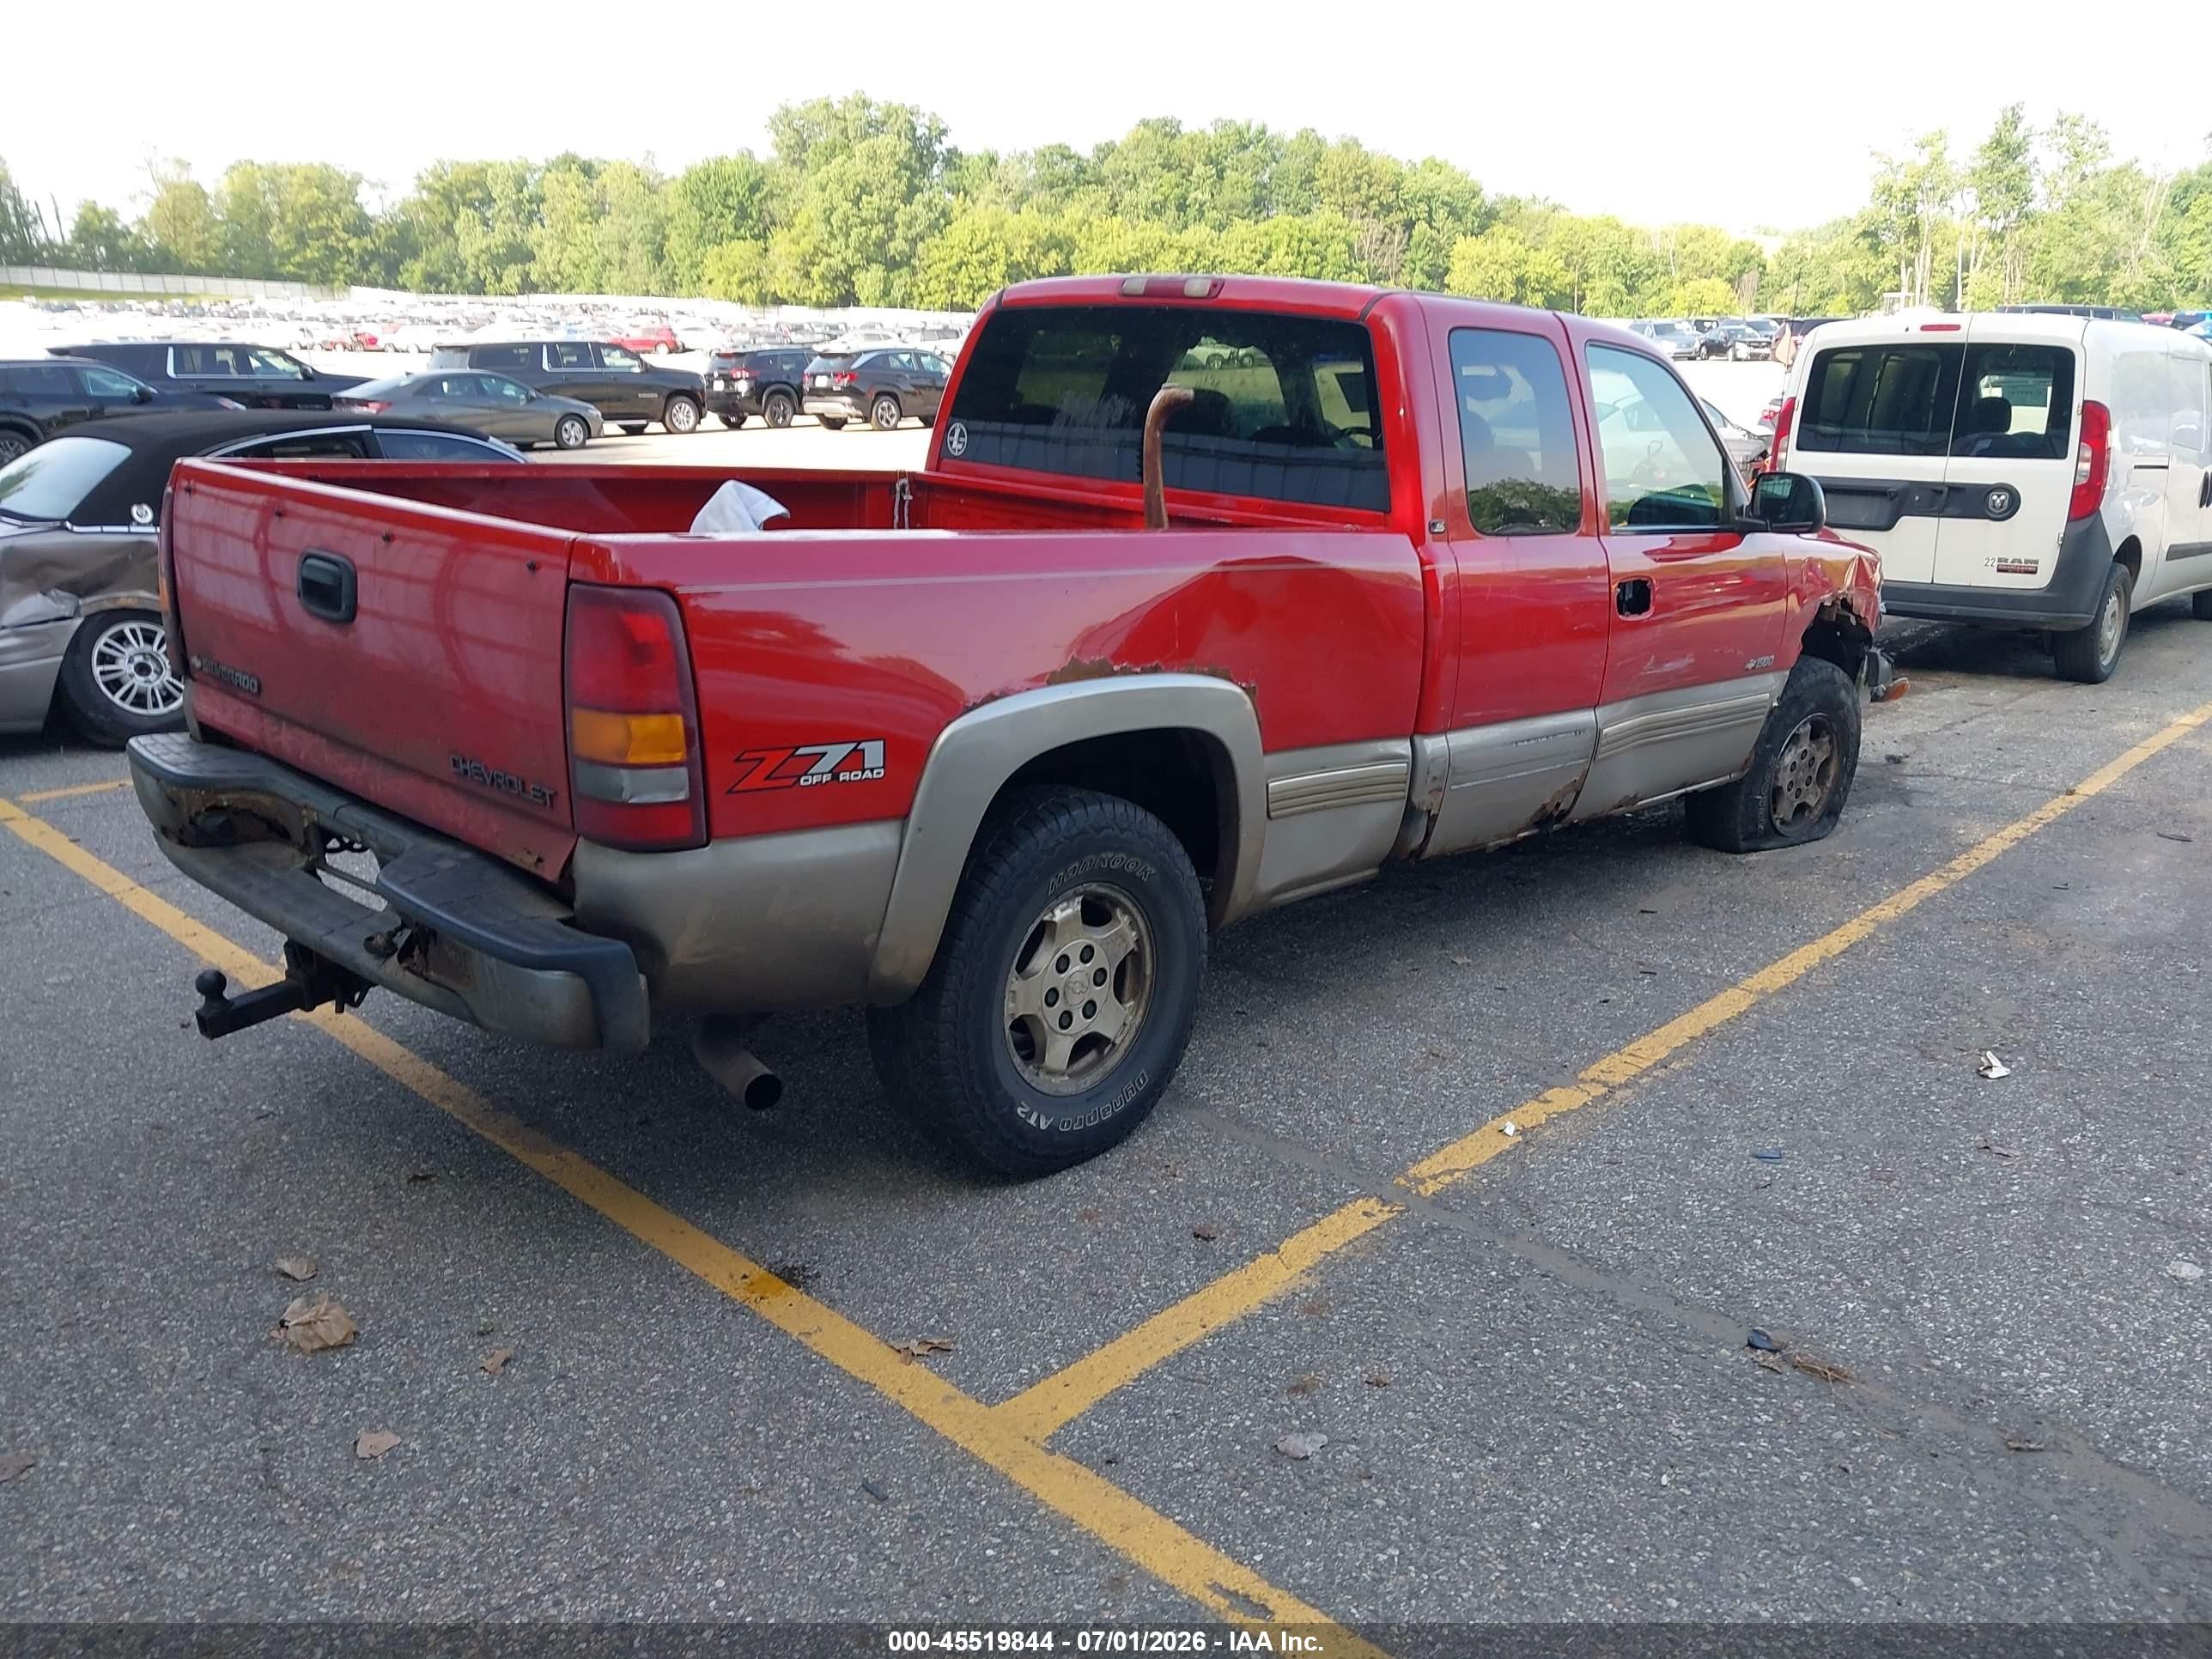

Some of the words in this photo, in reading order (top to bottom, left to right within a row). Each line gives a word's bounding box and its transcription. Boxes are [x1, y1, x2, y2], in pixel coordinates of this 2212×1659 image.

[1984, 556, 1996, 567] 22
[726, 738, 885, 794] Z71
[799, 772, 833, 787] OFF
[838, 768, 885, 783] ROAD
[449, 755, 556, 807] CHEVROLET
[1017, 1101, 1053, 1130] AT2
